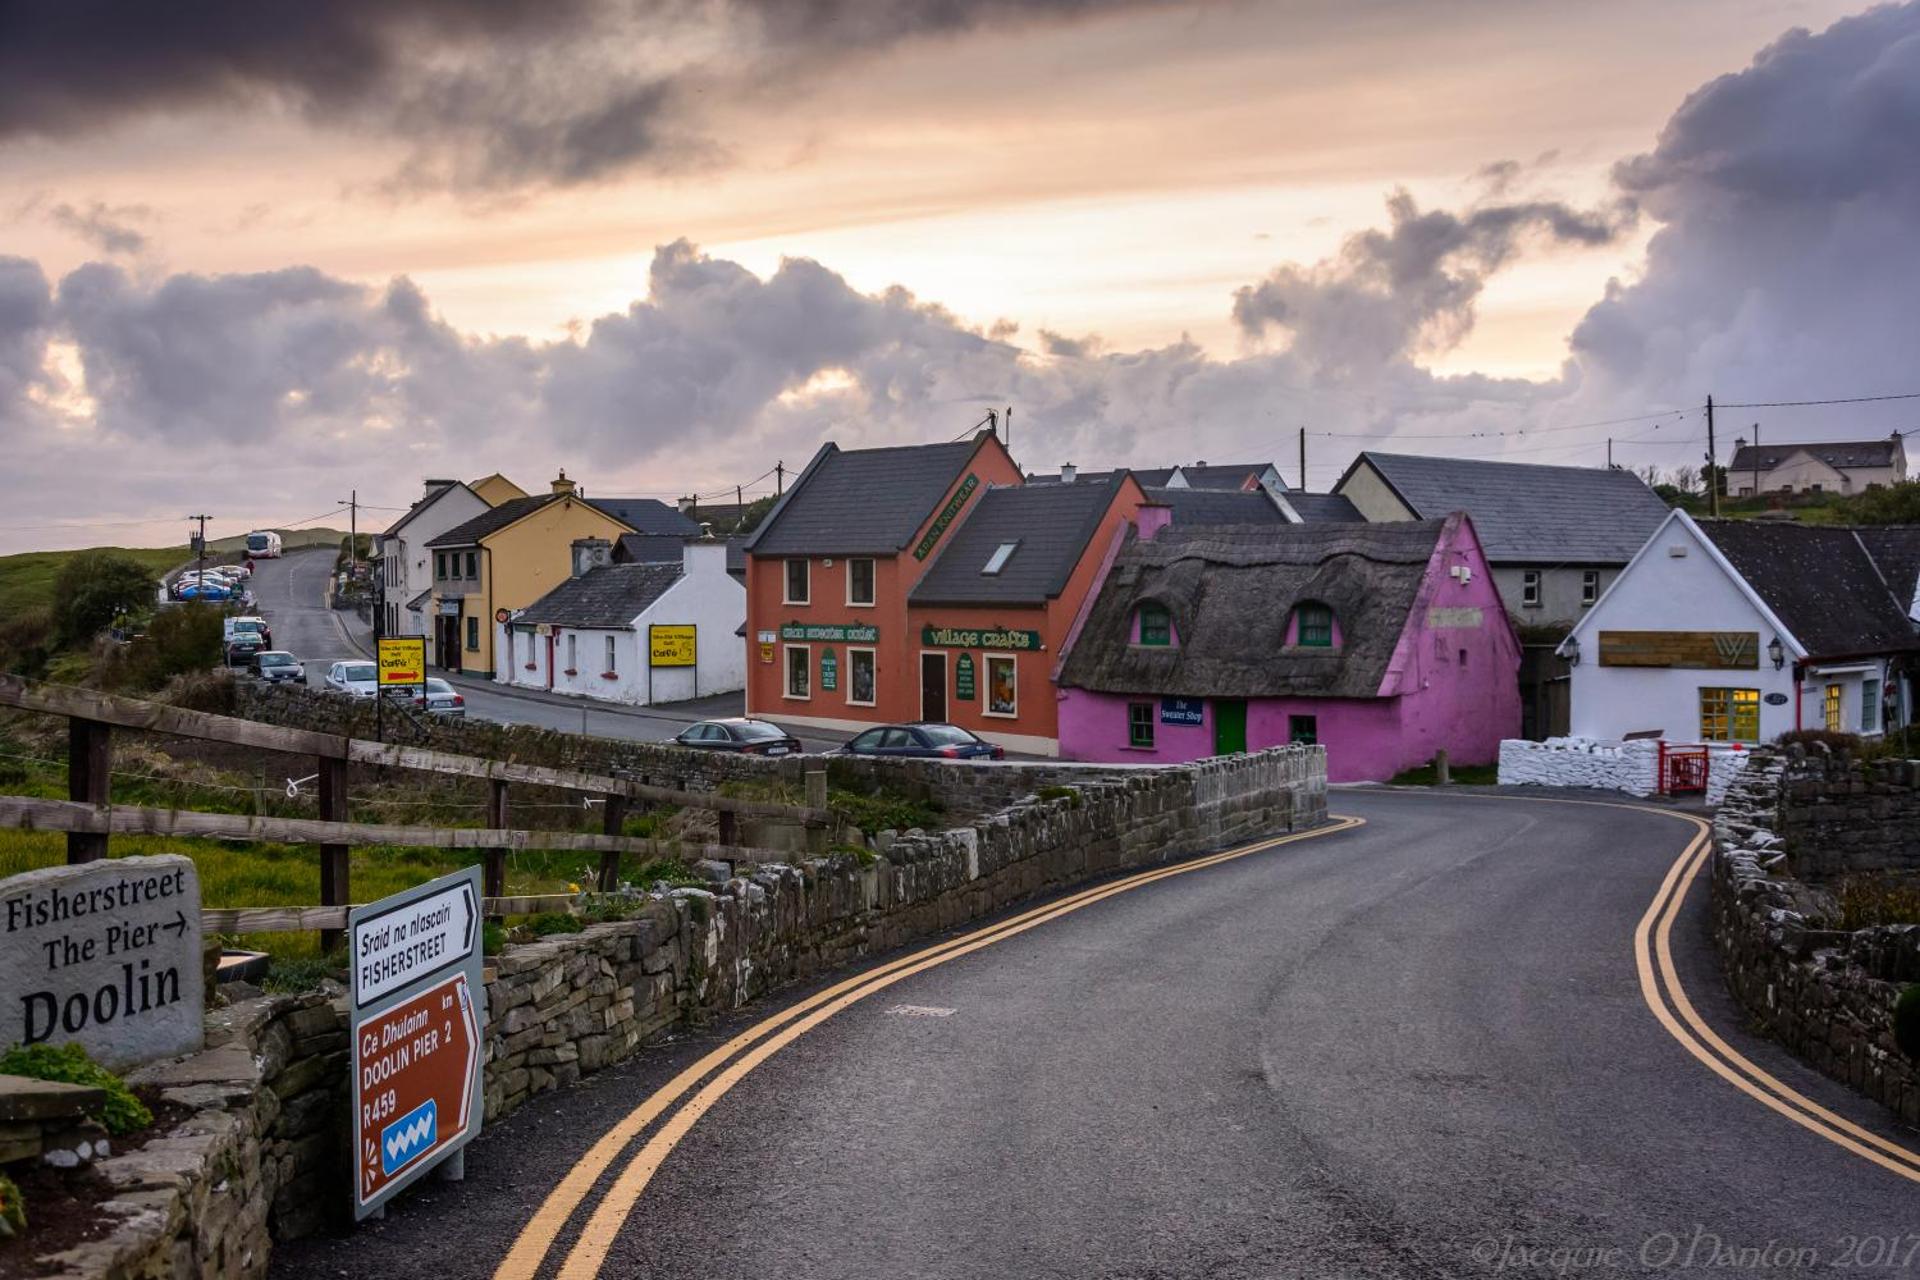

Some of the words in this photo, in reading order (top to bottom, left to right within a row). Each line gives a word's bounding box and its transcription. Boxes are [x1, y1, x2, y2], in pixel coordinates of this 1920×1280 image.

[1161, 710, 1186, 720] Sweater
[1186, 711, 1202, 723] Shop
[5, 867, 185, 933] Fisherstreet
[43, 935, 96, 971] The
[106, 921, 160, 956] Pier
[393, 924, 407, 944] na
[362, 932, 447, 990] FISHERSTREET
[20, 959, 181, 1047] Doolin
[442, 994, 453, 1010] km
[362, 1031, 379, 1058] Cé
[364, 1045, 409, 1090] DOOLIN
[414, 1029, 439, 1062] PIER
[444, 1020, 452, 1043] 2
